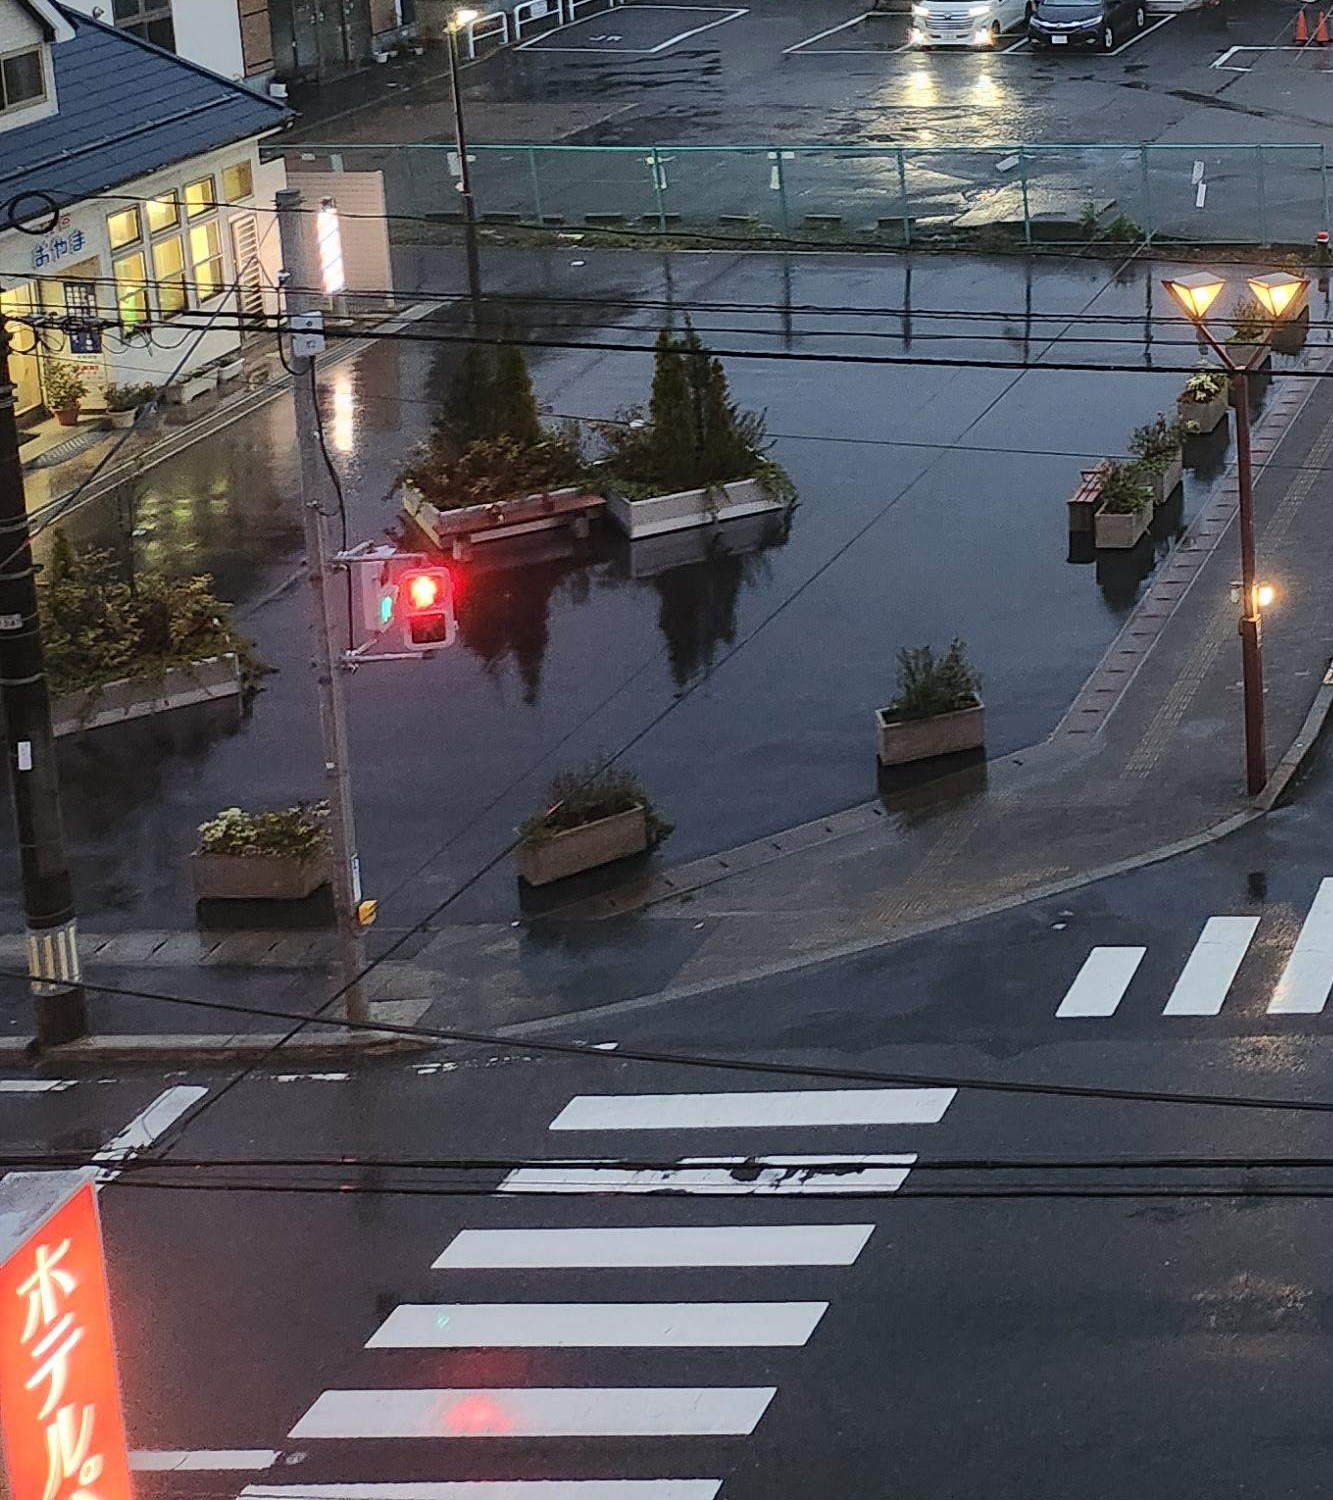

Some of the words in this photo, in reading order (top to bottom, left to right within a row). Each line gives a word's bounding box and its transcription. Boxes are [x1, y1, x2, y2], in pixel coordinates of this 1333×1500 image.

[34, 229, 86, 268] おやま
[16, 1238, 103, 1500] ホテル
